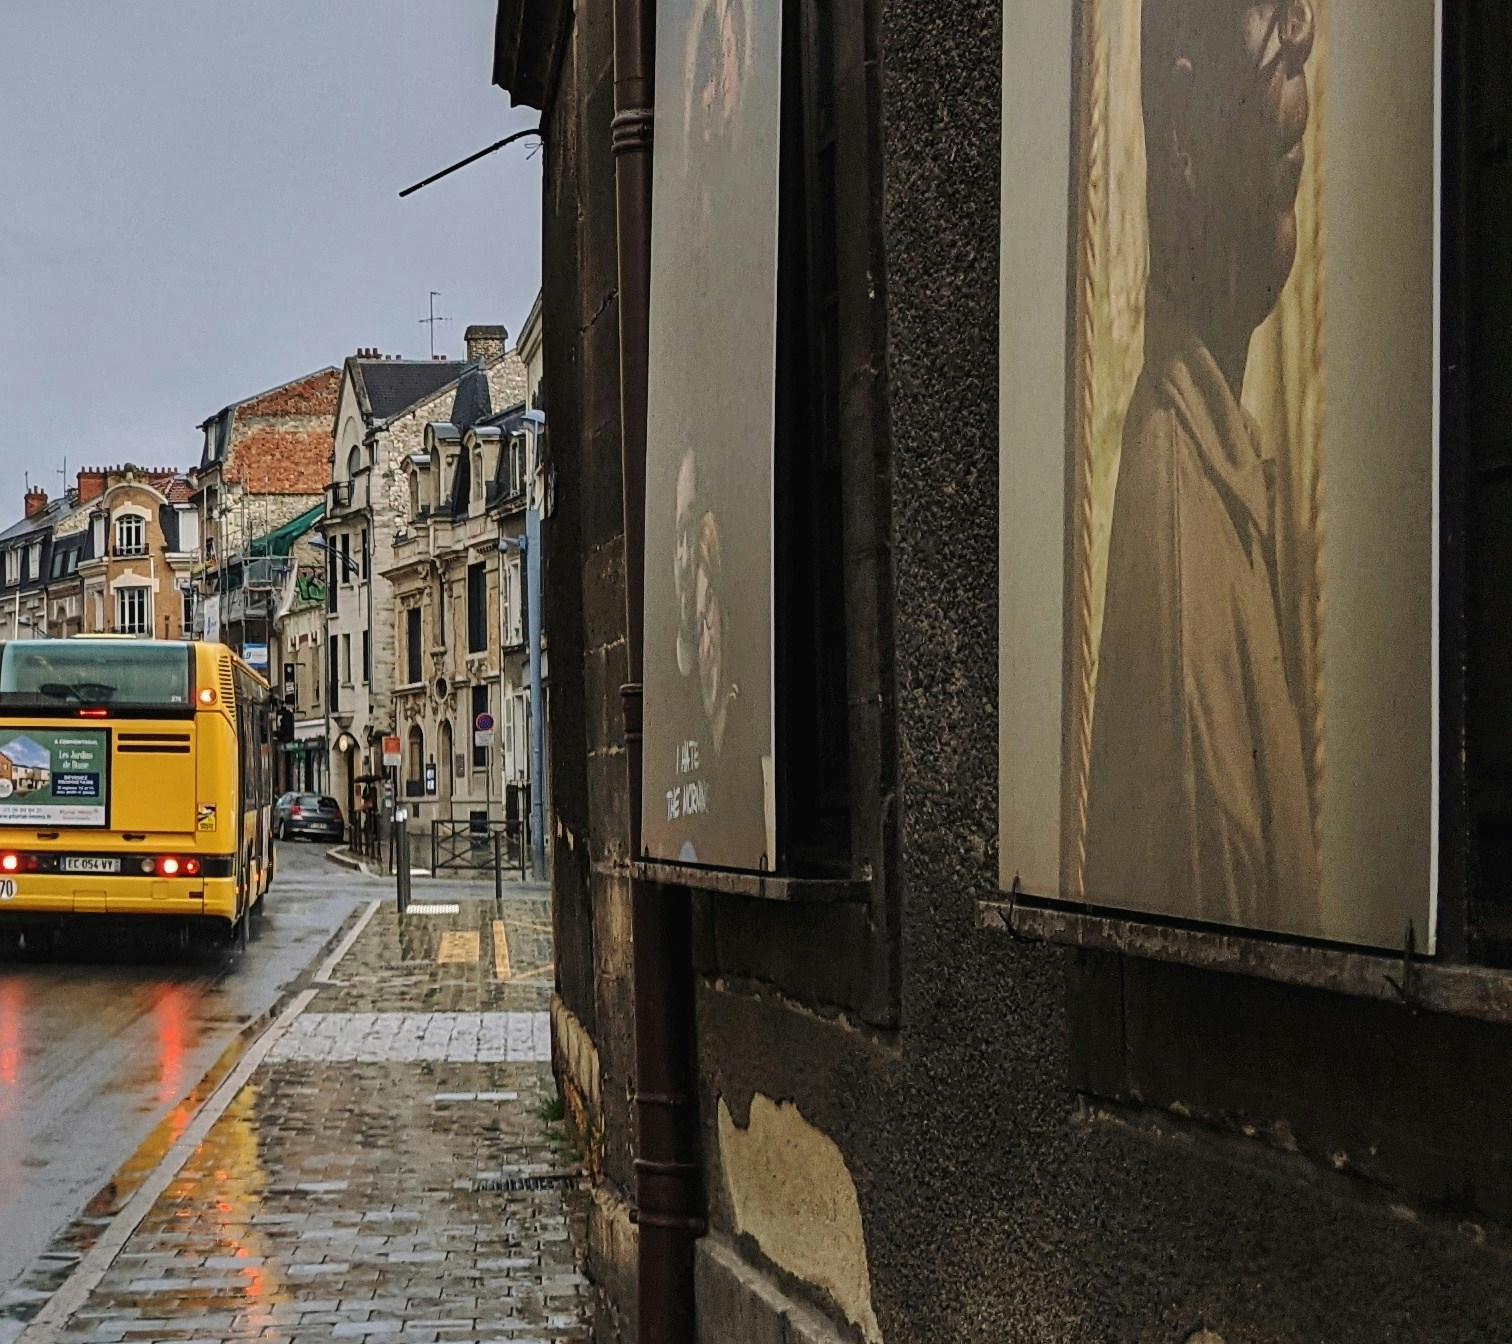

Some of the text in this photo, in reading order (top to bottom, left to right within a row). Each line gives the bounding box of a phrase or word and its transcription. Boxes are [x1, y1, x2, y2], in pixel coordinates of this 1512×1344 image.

[666, 787, 681, 822] THE
[68, 858, 80, 869] EC
[101, 859, 113, 870] VY
[0, 880, 13, 898] 70
